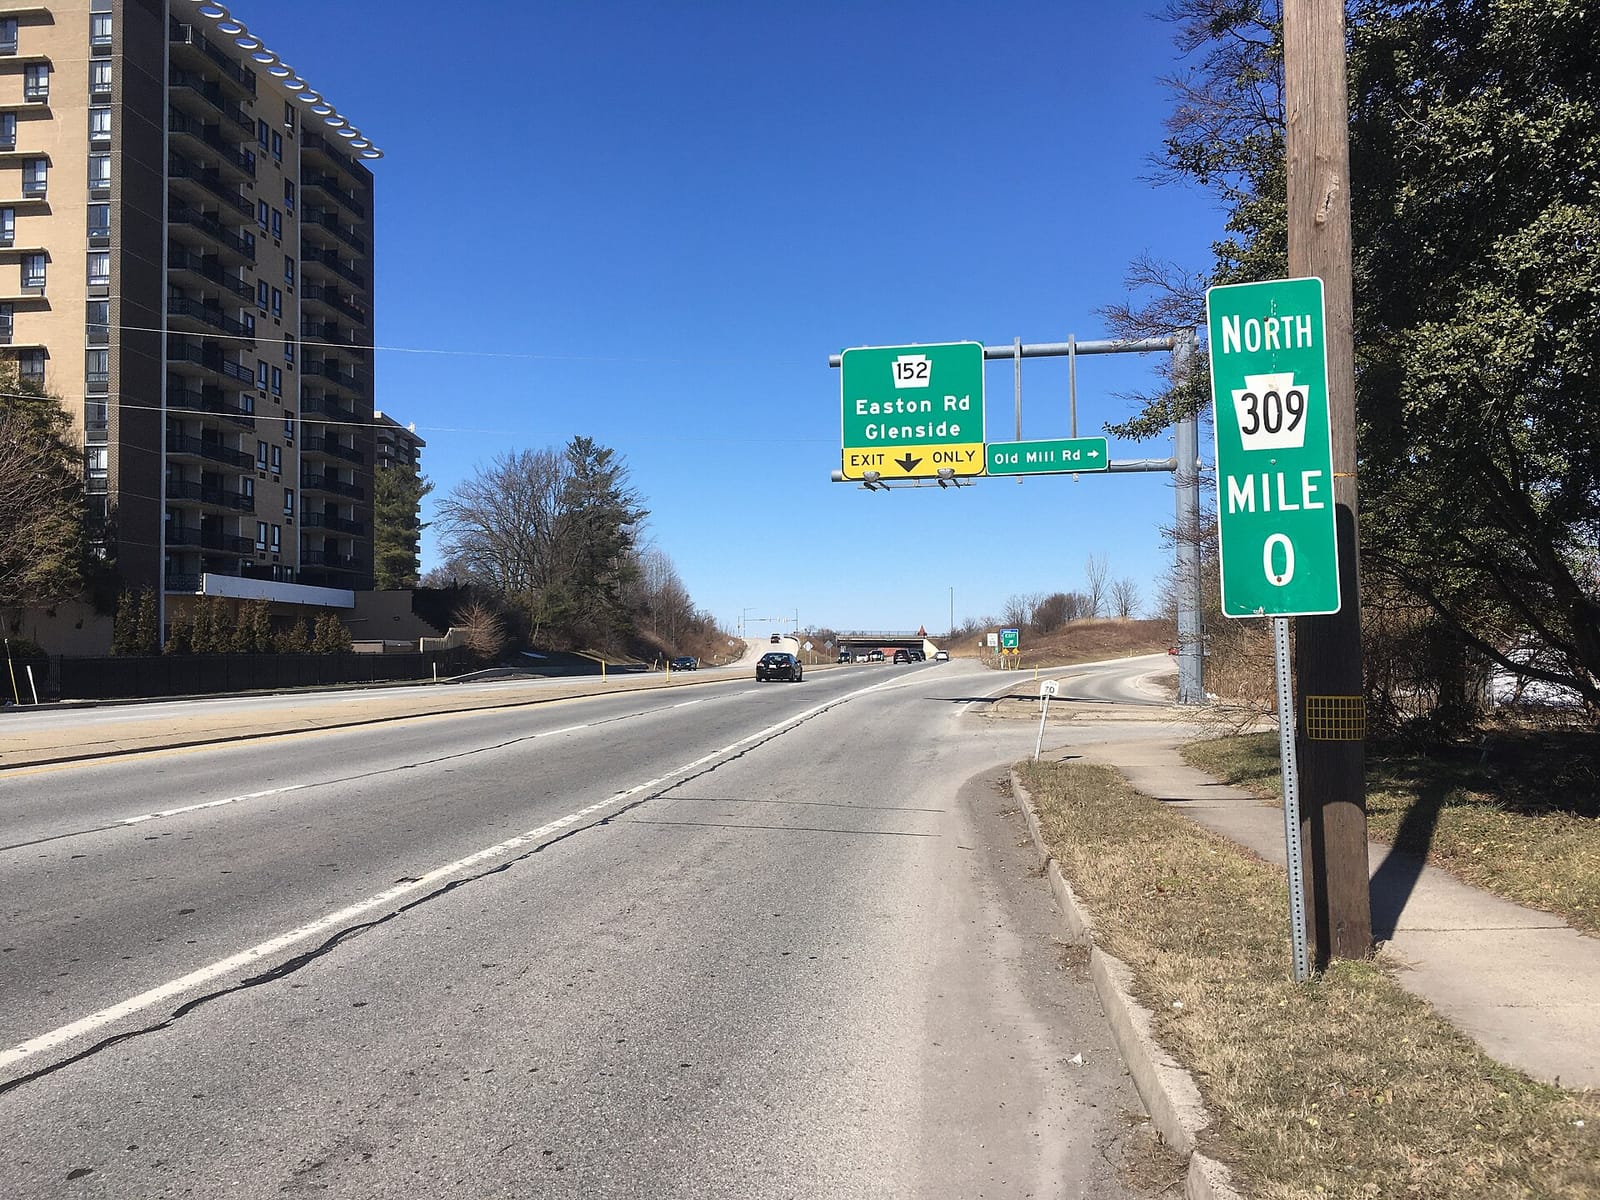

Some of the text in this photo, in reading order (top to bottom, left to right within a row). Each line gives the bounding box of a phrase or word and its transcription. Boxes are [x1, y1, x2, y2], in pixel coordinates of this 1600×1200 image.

[1222, 314, 1313, 354] NORTH
[896, 362, 928, 380] 152
[856, 395, 970, 416] Easton Rd
[1241, 390, 1305, 436] 309
[865, 421, 961, 440] Glenside
[850, 450, 976, 466] EXIT ONLY
[994, 449, 1081, 465] Old Mill Rd
[1228, 470, 1325, 514] MILE
[1263, 533, 1295, 587] 0
